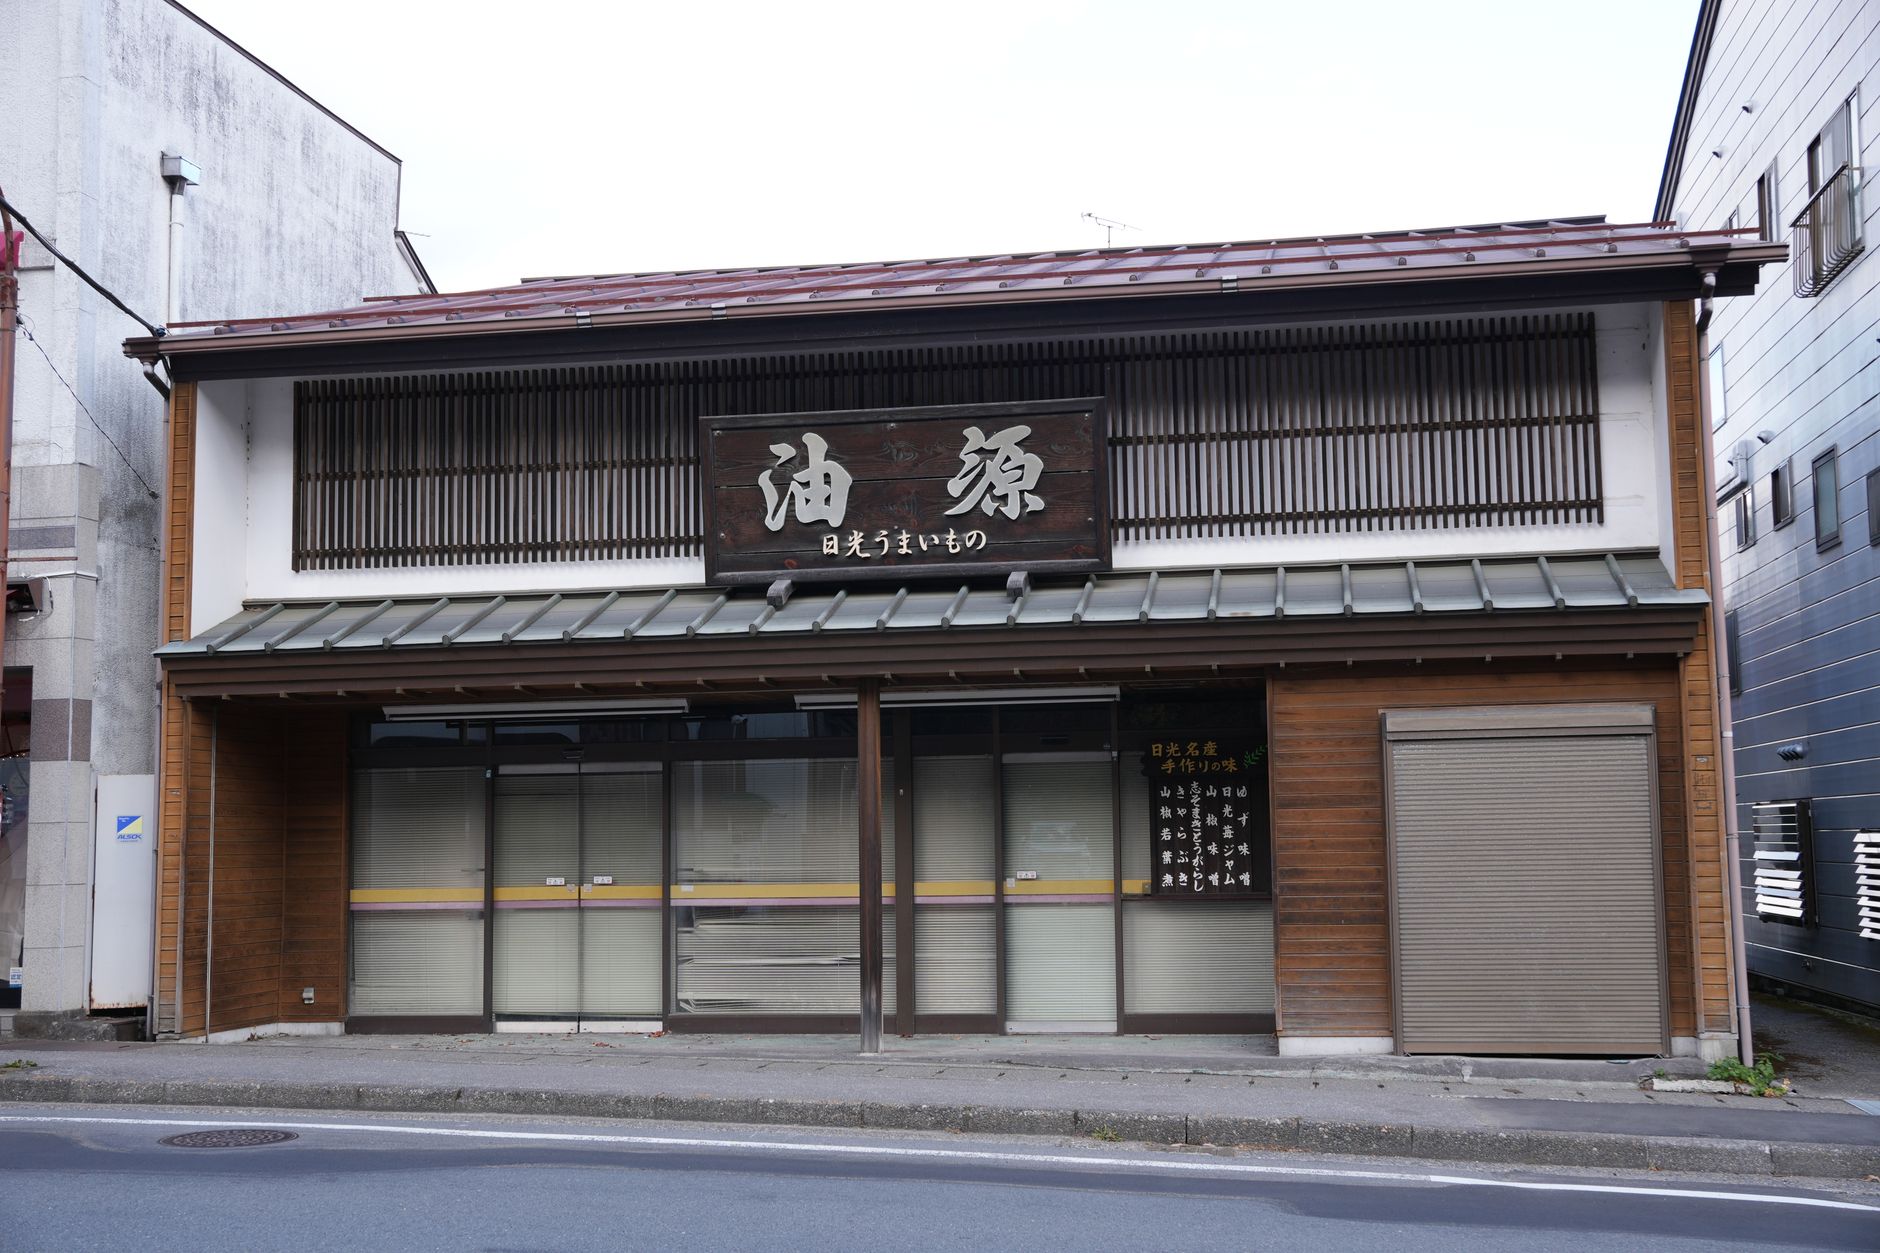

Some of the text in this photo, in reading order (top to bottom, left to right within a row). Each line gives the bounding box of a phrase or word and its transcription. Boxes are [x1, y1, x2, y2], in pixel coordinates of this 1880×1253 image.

[758, 425, 1045, 532] 油源
[822, 528, 988, 559] 日光うまいもの
[1151, 741, 1218, 757] 日光名産
[1160, 757, 1239, 774] 手作りの味
[1160, 786, 1174, 887] 山椒若葉煮
[1205, 785, 1220, 886] 山椒味噌
[1236, 785, 1251, 886] ゆず味噌
